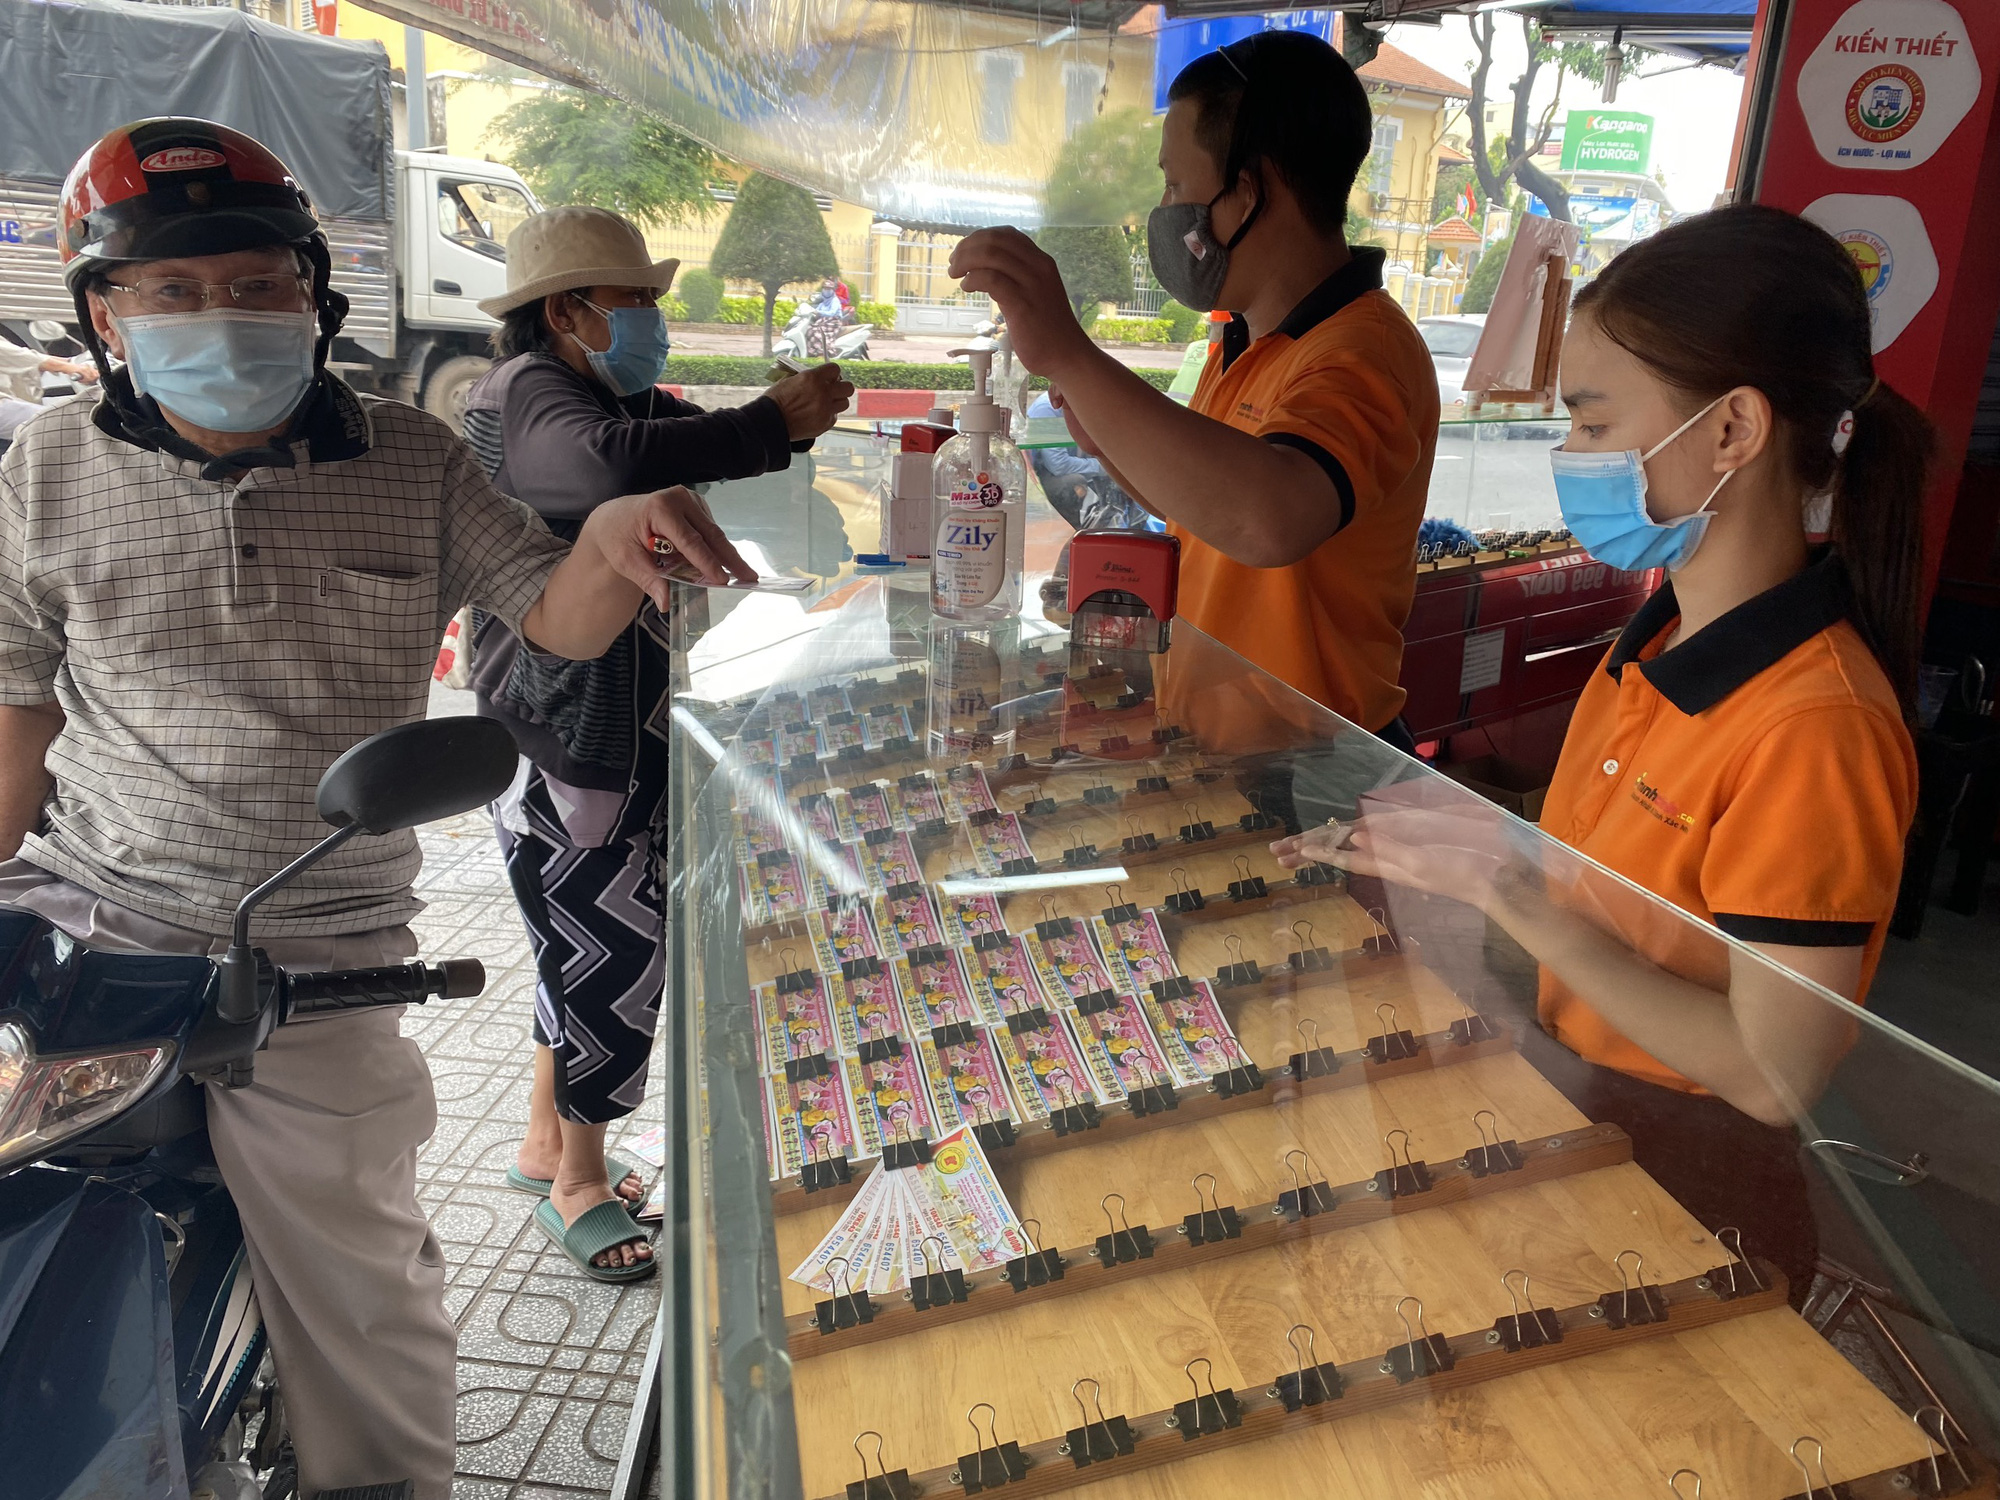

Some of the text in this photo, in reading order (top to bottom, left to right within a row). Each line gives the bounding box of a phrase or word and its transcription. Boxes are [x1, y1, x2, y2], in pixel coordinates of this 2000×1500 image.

[1835, 28, 1958, 56] KIẾN THIẾT
[1581, 148, 1639, 162] HYDROGEN
[951, 488, 999, 501] Max 3D
[947, 525, 998, 551] Zily
[933, 1080, 959, 1128] 26748
[818, 1236, 843, 1265] 654407
[852, 1243, 871, 1272] 654407
[881, 1243, 894, 1271] 654407
[912, 1240, 923, 1266] 654407
